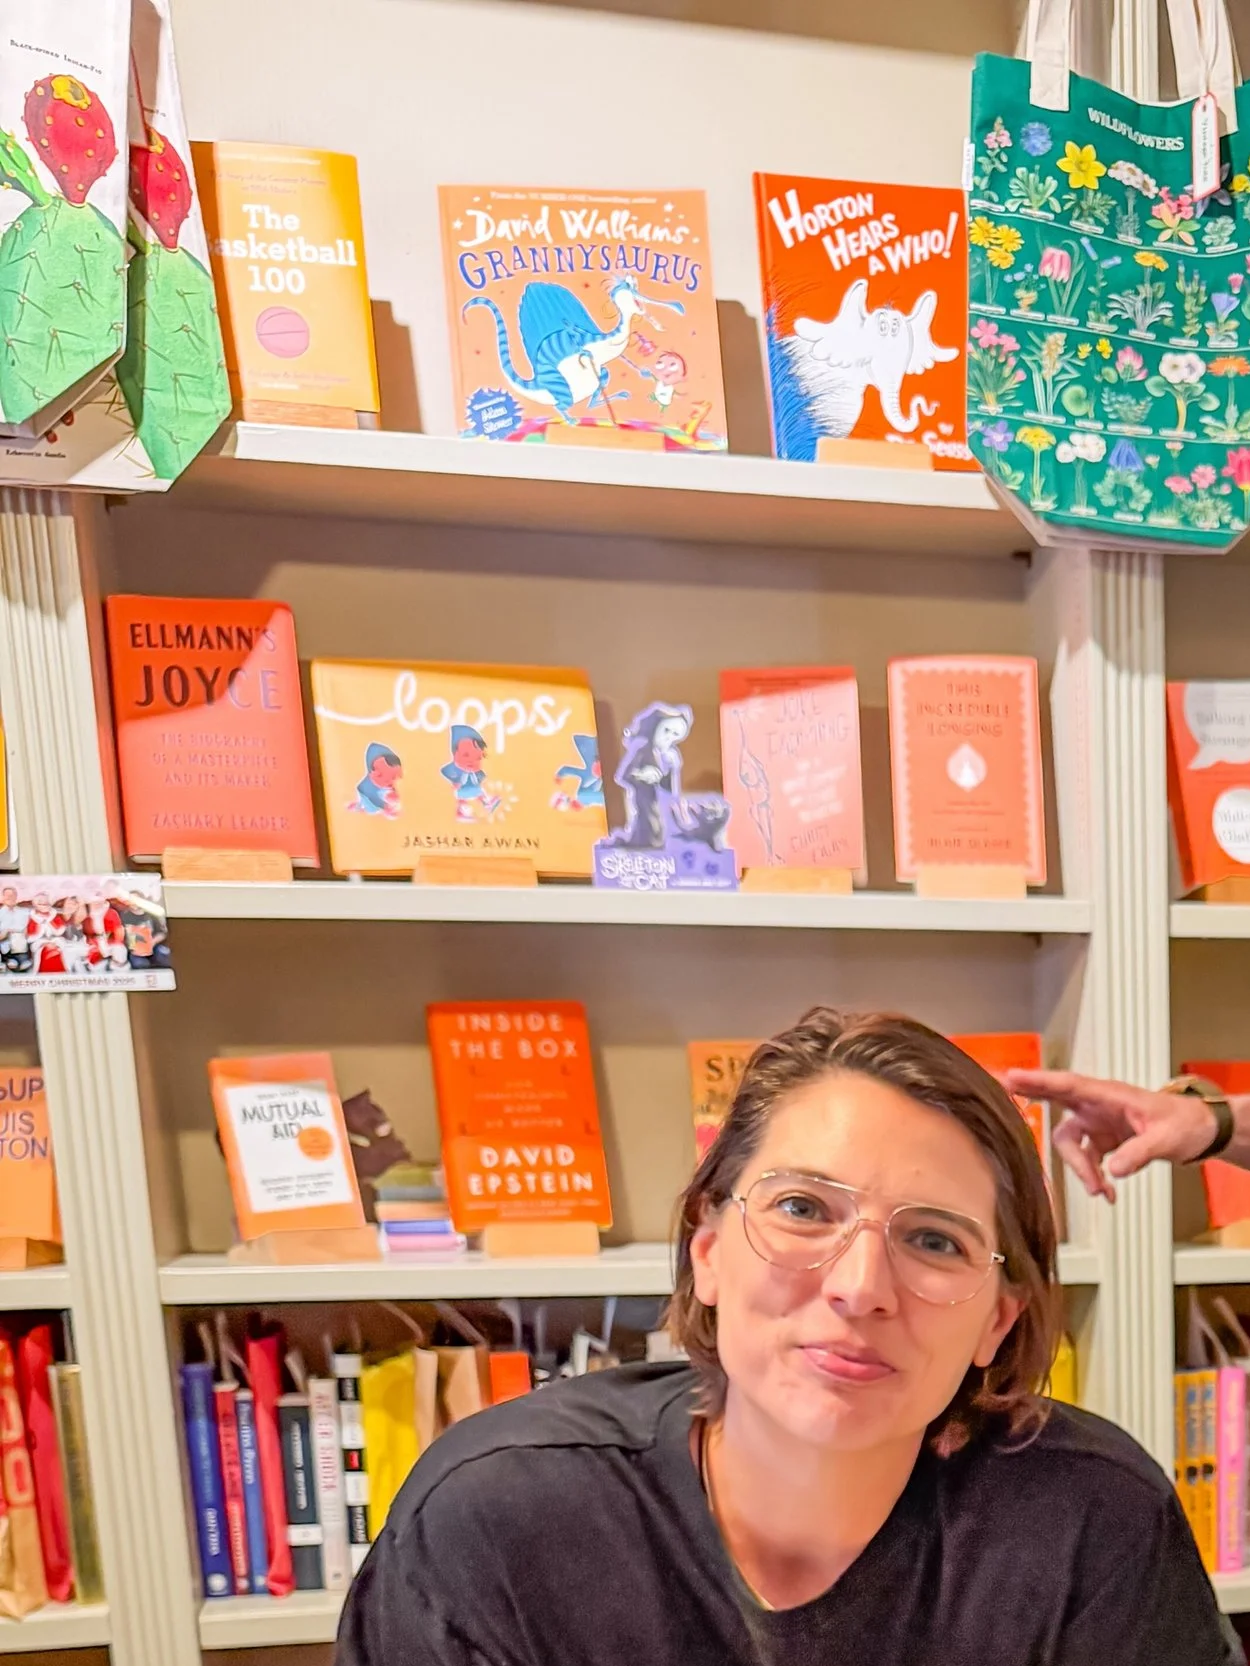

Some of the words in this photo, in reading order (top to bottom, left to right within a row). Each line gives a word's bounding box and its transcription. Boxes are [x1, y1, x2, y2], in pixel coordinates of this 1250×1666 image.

[1087, 107, 1184, 151] WILDFLOWERS
[241, 203, 300, 231] The
[458, 205, 553, 248] David
[559, 208, 690, 245] Walliams
[767, 189, 873, 249] HORTON
[822, 213, 900, 271] HEARS
[868, 254, 886, 275] A
[883, 212, 959, 274] WHO!
[248, 265, 306, 295] 100
[458, 244, 702, 291] GRANNYSAURUS
[130, 623, 277, 652] ELLMANN'S
[135, 664, 283, 713] JOYCE
[314, 670, 572, 754] loops
[153, 814, 226, 830] ZACHARY
[232, 815, 291, 831] LEADER
[457, 1012, 564, 1032] INSIDE
[449, 1038, 503, 1060] THE
[518, 1038, 578, 1059] BOX
[242, 1100, 324, 1125] MUTUAL
[479, 1144, 576, 1168] DAVID
[467, 1172, 593, 1196] EPSTEIN
